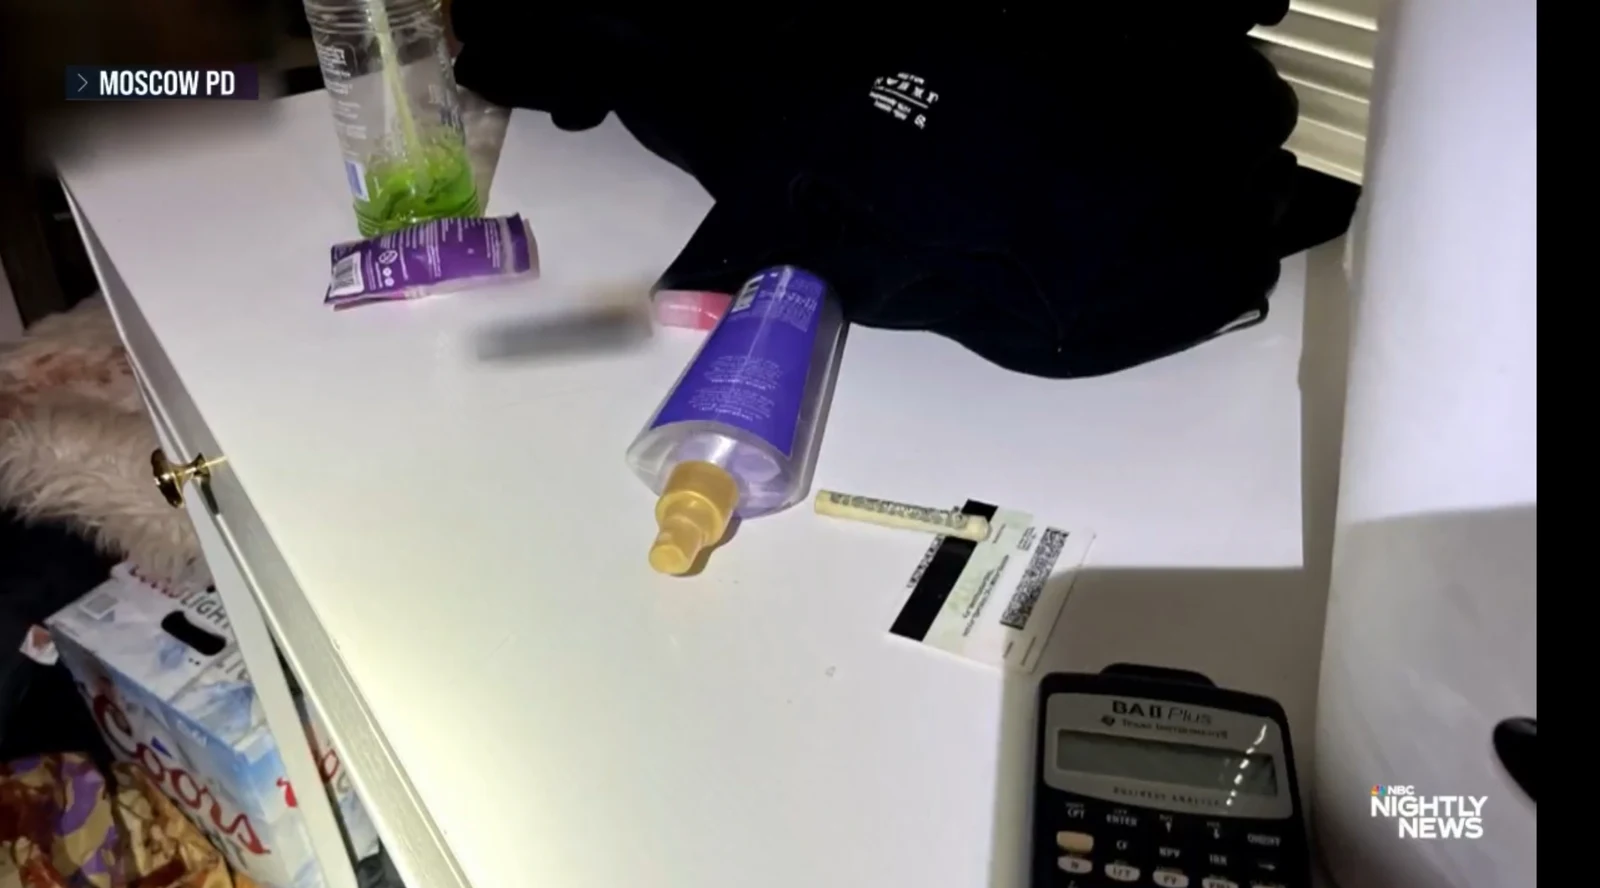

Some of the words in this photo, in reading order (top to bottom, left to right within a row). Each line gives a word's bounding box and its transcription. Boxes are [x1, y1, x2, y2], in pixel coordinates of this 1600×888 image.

[1112, 699, 1145, 717] BA
[1167, 705, 1212, 726] Plus
[93, 690, 272, 856] Coors
